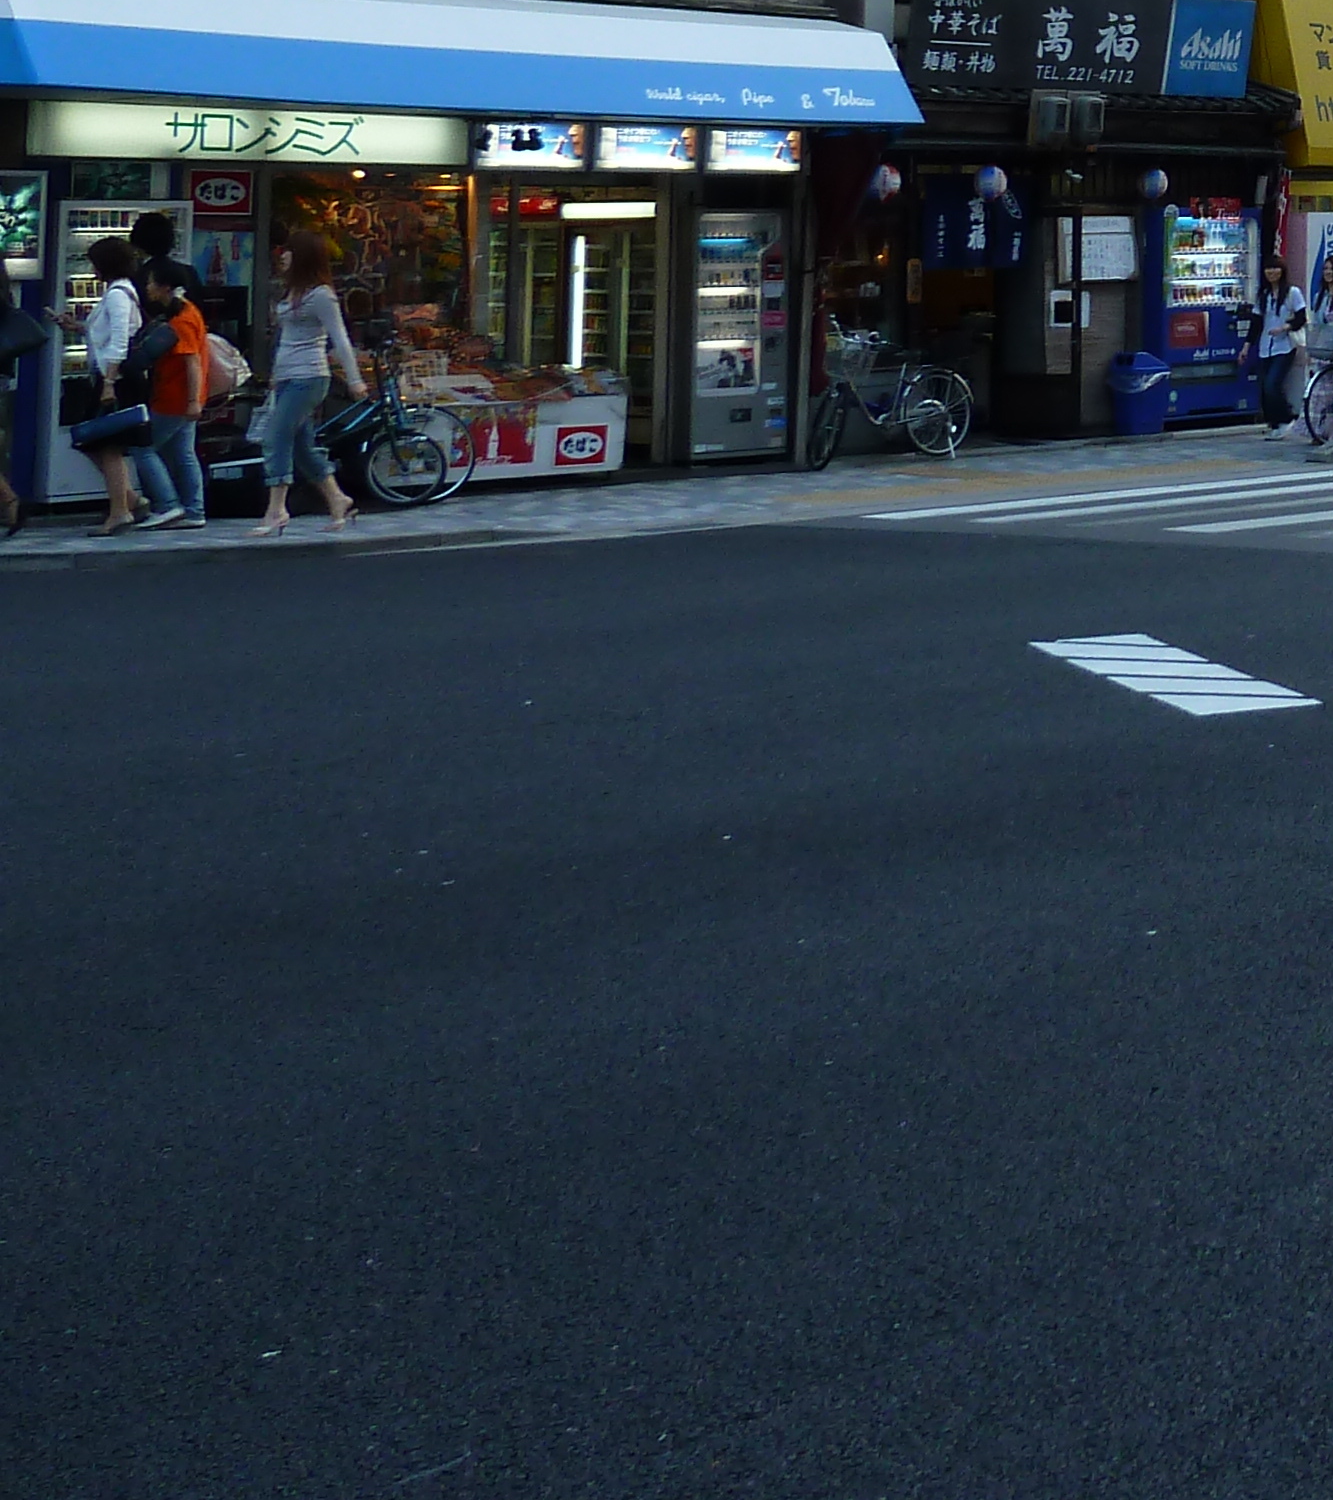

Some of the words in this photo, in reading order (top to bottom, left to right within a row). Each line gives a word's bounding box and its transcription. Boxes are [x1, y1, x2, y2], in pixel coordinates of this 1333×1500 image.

[928, 11, 1002, 36] 中華そば
[1036, 6, 1140, 64] 萬福
[1180, 28, 1242, 61] Asahi
[1035, 65, 1135, 85] TEL.221-4712
[1179, 60, 1202, 71] SOFT
[1203, 60, 1238, 72] DRINKS
[742, 88, 775, 106] Pipe
[802, 95, 814, 109] &
[166, 112, 364, 155] サロンシミズ
[199, 182, 240, 200] たばこ
[564, 436, 598, 454] たばこ
